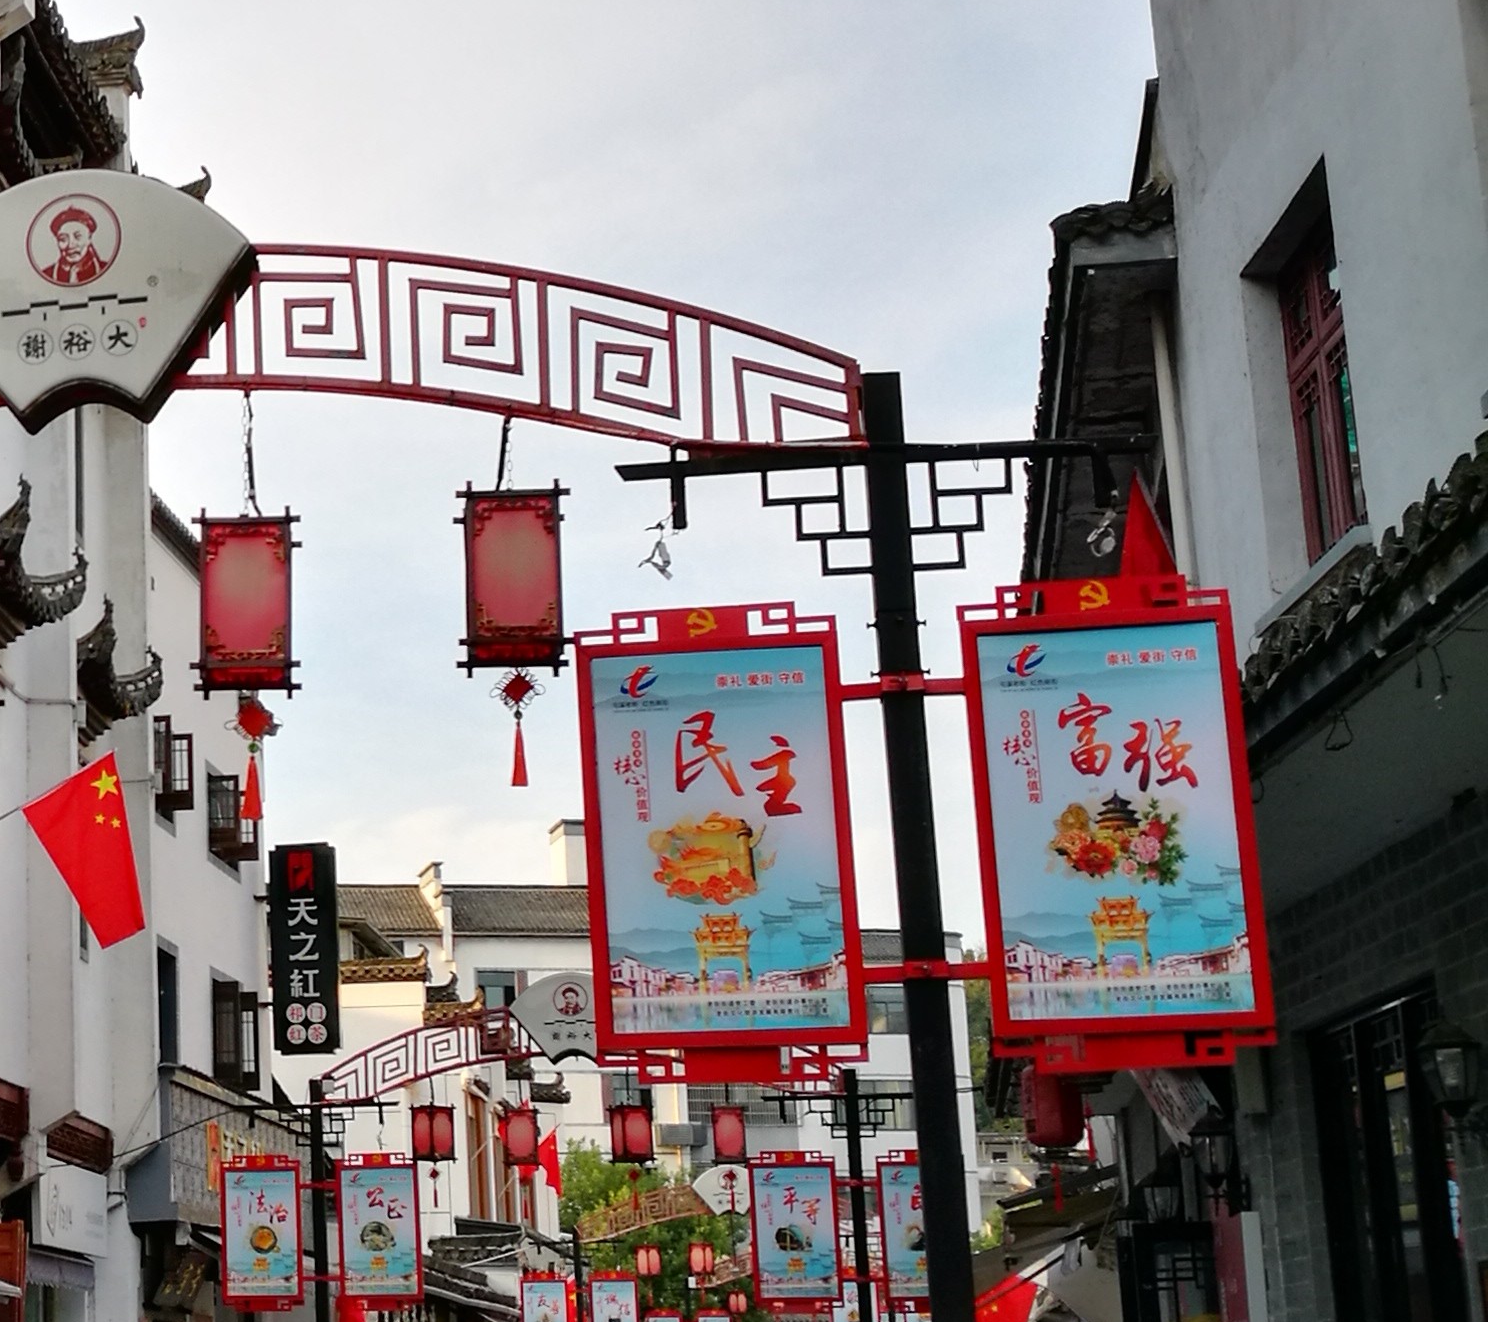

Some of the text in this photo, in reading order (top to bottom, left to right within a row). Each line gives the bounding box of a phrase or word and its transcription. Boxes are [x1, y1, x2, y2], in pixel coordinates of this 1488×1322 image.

[22, 325, 134, 358] 謝裕大
[1171, 649, 1196, 661] 守信
[716, 671, 804, 687] 崇礼 爱街 守信
[1058, 692, 1198, 792] 富强
[675, 710, 803, 816] 民主
[287, 897, 320, 998] 天之紅
[288, 1004, 325, 1022] 祁门
[289, 1025, 325, 1042] 红茶
[249, 1188, 288, 1224] 法治
[366, 1187, 407, 1219] 公正
[783, 1186, 821, 1226] 平等
